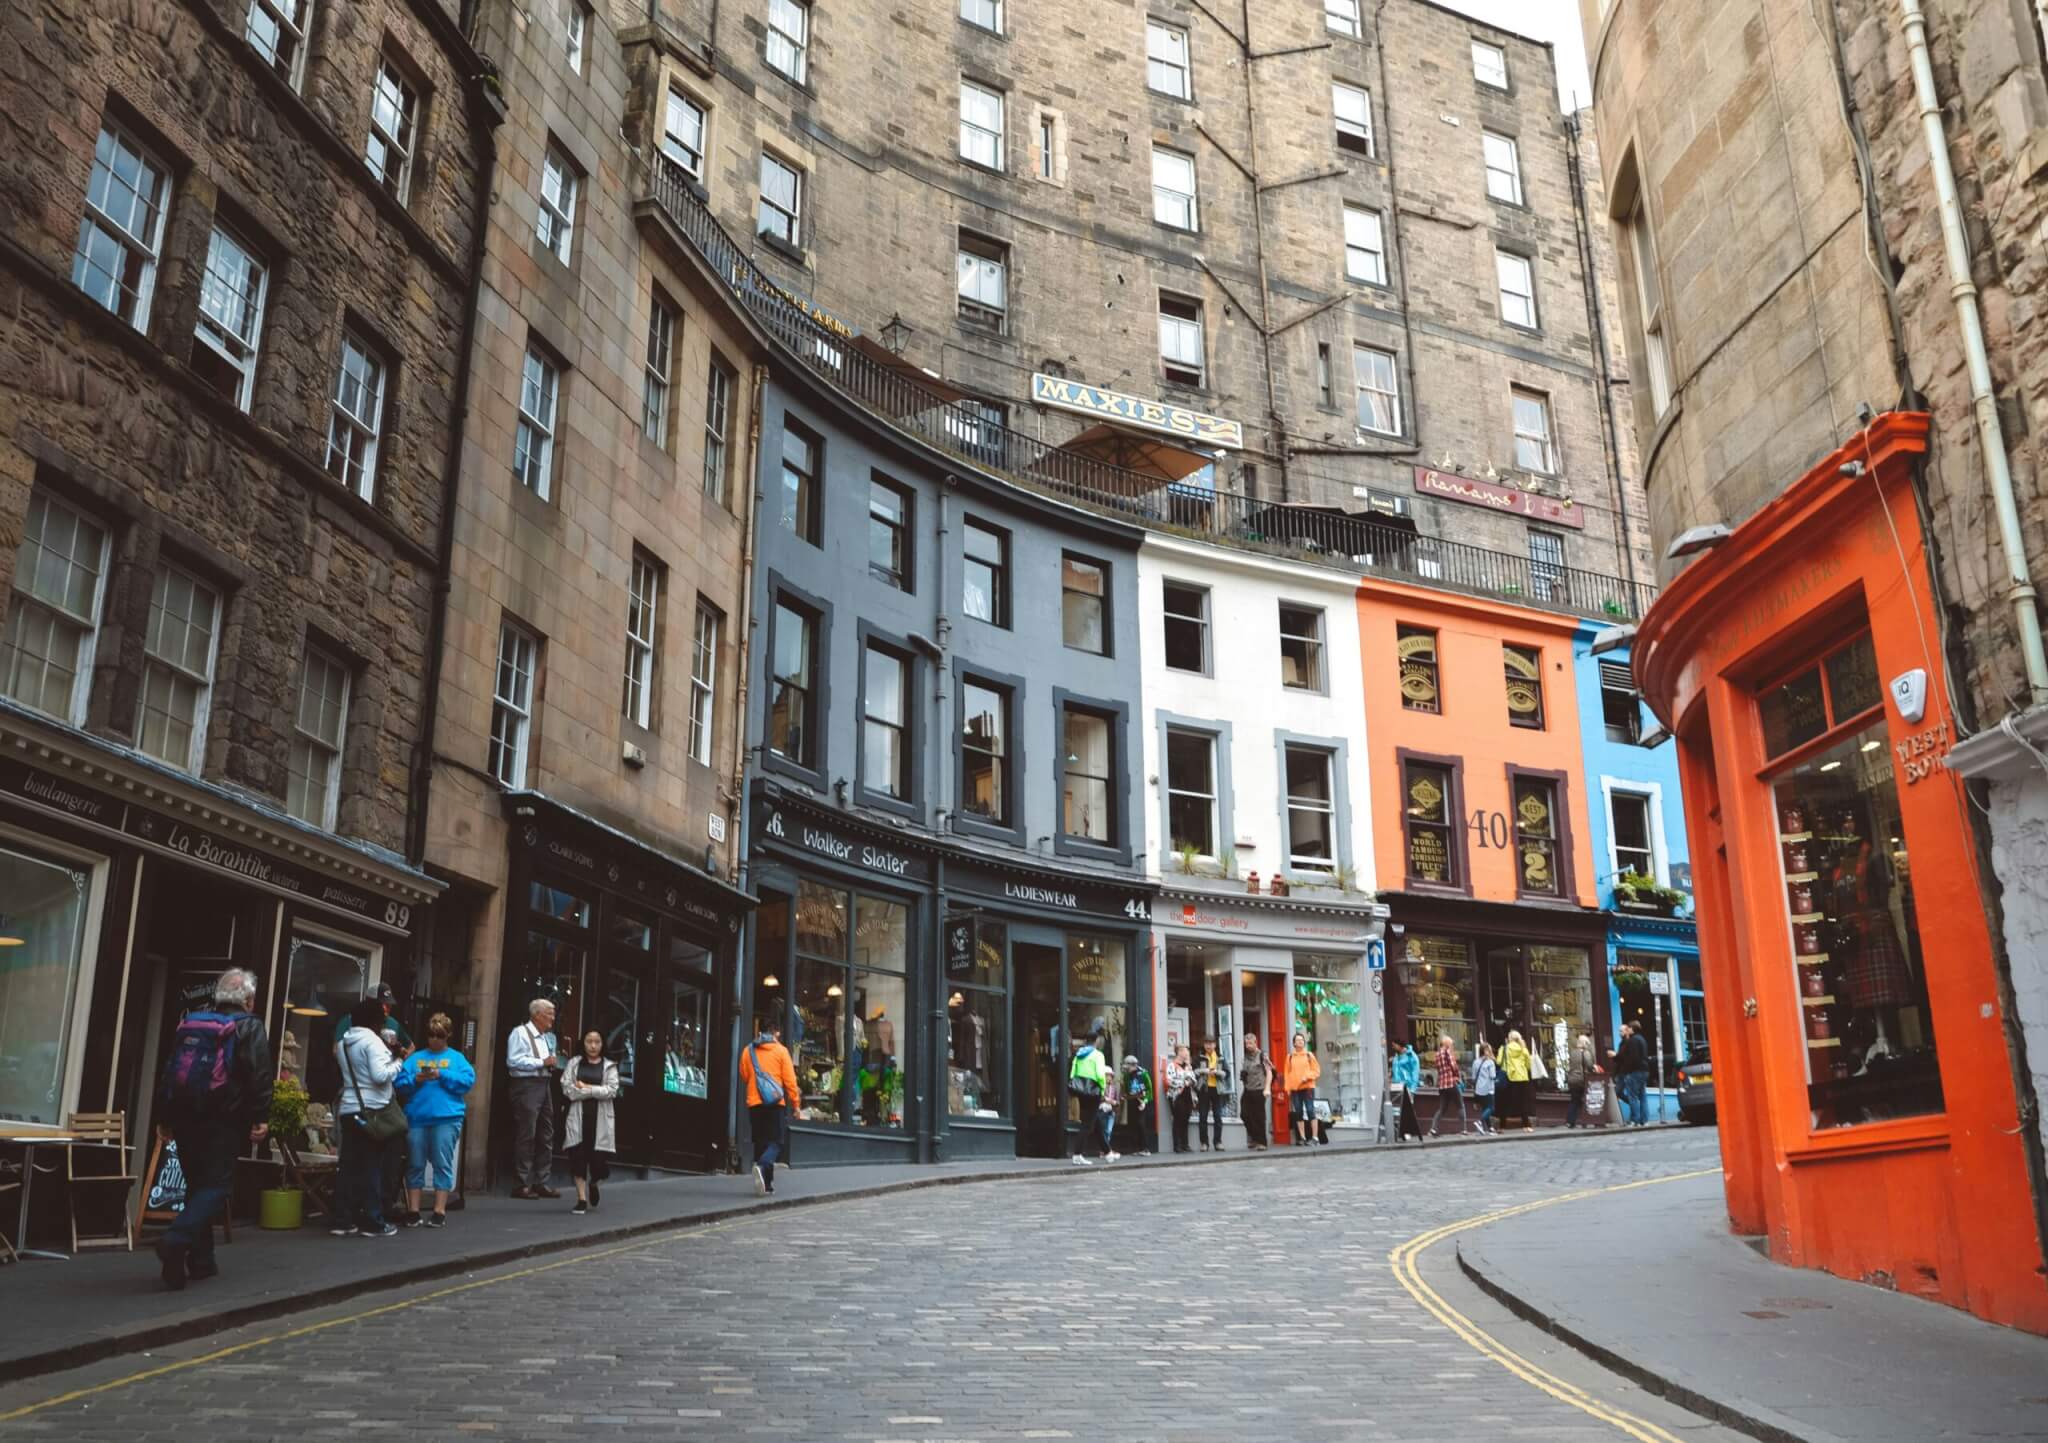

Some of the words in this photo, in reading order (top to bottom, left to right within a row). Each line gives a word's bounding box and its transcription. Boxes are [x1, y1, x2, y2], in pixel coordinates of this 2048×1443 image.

[1040, 378, 1197, 434] MAXIES
[1896, 722, 1947, 765] WEST
[23, 771, 101, 817] boulangerie
[1524, 803, 1543, 816] BEST
[1412, 838, 1443, 848] WORLD
[1467, 809, 1508, 850] 40
[167, 824, 191, 854] La
[194, 833, 273, 881] Barantine
[803, 827, 855, 860] Walker
[861, 845, 910, 875] Slater
[1523, 852, 1549, 881] 2
[1004, 882, 1077, 909] LADIESWEAR
[385, 901, 411, 929] 89
[1169, 911, 1184, 922] the
[1198, 911, 1217, 924] door
[1219, 917, 1249, 930] gallery
